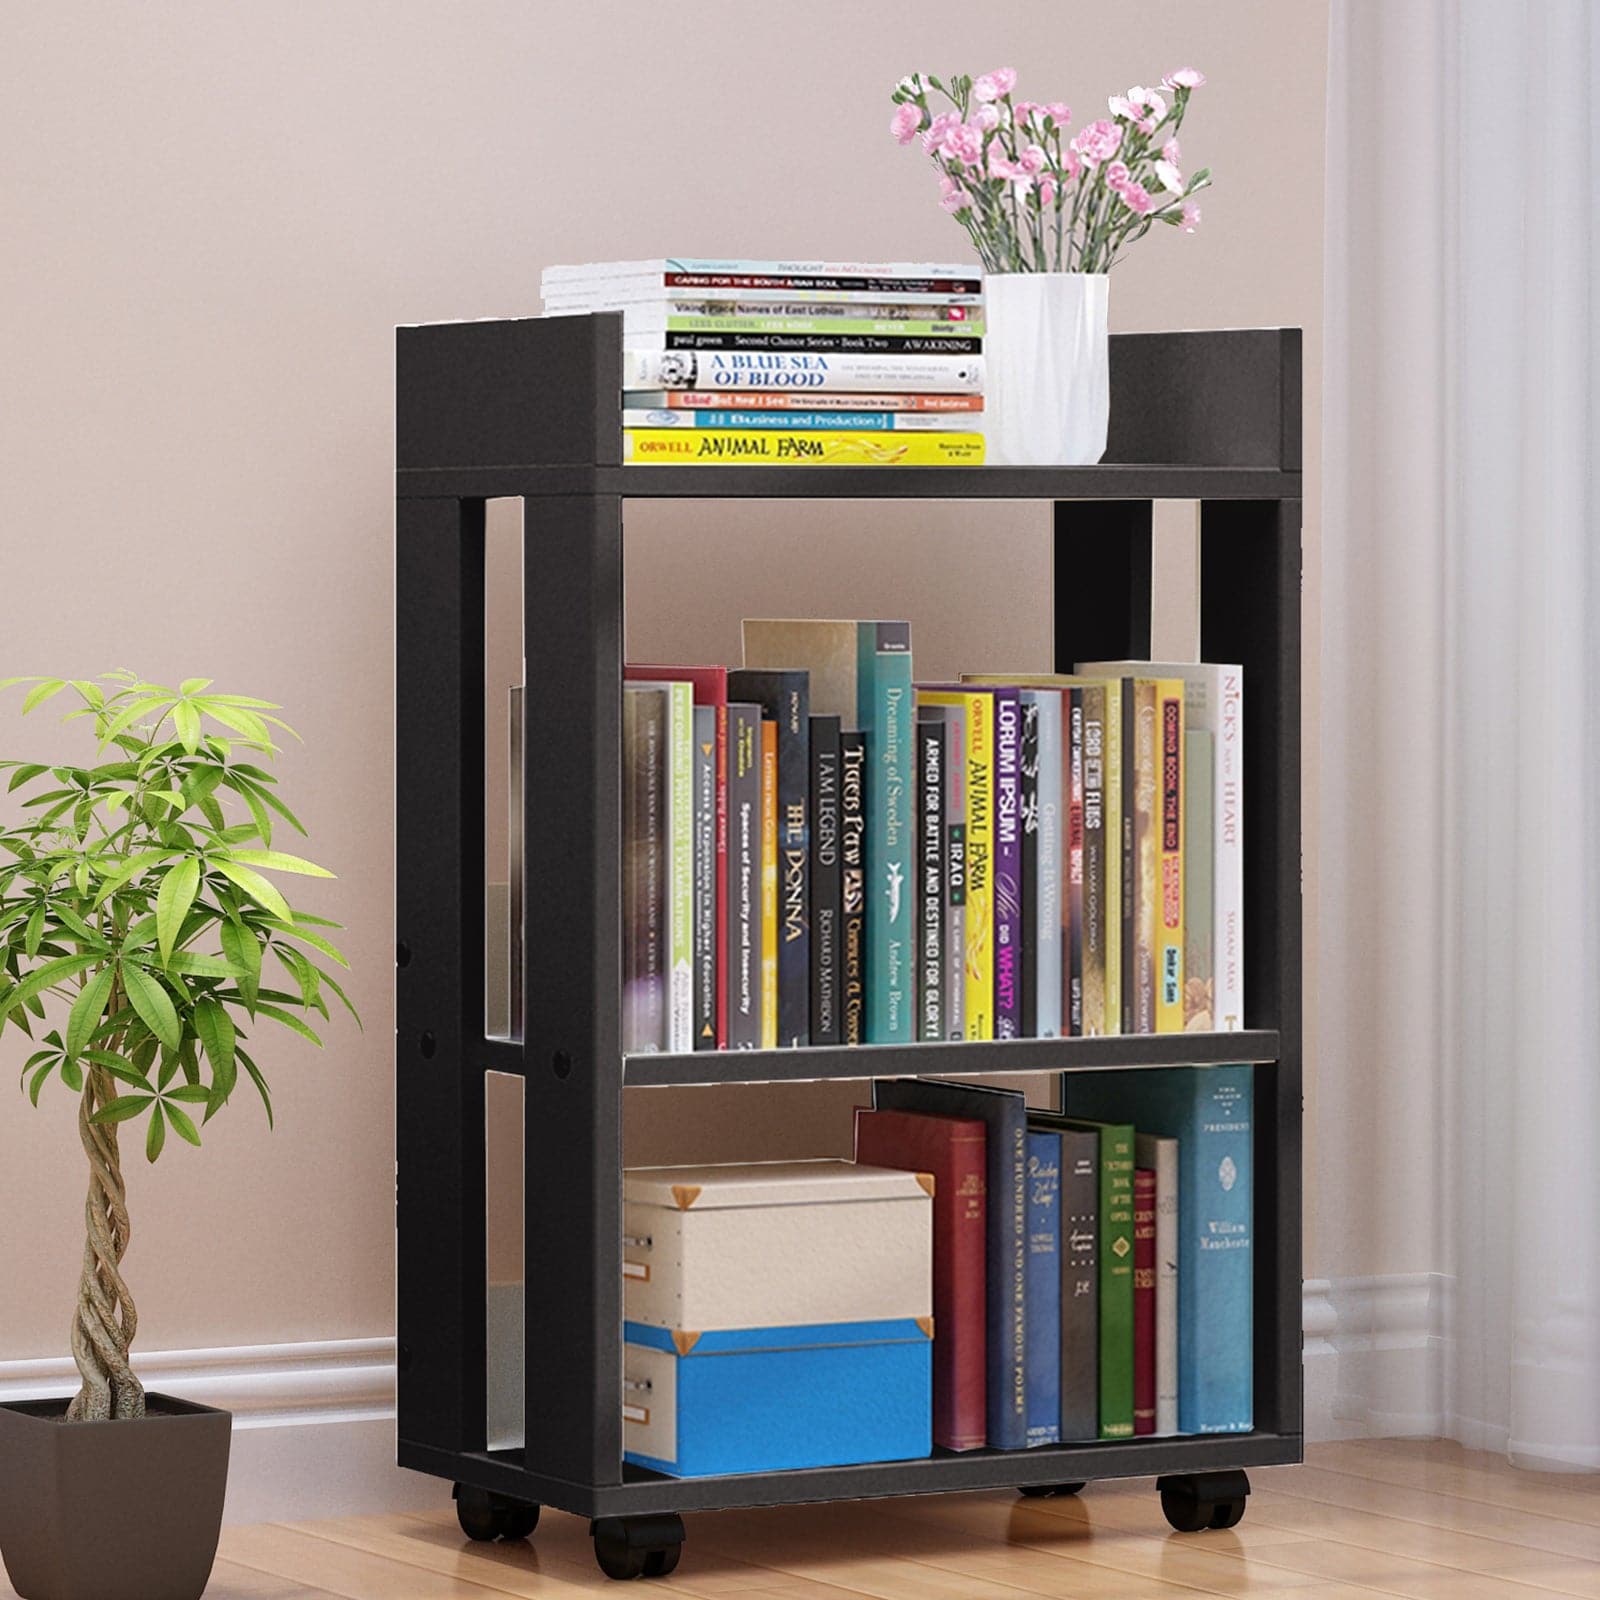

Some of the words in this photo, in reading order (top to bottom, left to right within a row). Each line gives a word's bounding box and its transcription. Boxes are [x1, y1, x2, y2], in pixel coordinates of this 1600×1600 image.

[674, 276, 710, 284] CARING
[712, 277, 731, 285] FOR
[733, 277, 751, 285] THE
[787, 278, 814, 287] ASIAN
[675, 303, 706, 315] Viking
[737, 304, 770, 315] Names
[772, 305, 783, 315] of
[785, 305, 807, 315] East
[809, 305, 845, 317] Lothian
[673, 334, 695, 347] paul
[696, 336, 723, 347] green
[735, 334, 768, 346] Second
[770, 335, 806, 347] Chance
[807, 336, 835, 347] Series
[841, 337, 865, 347] Book
[868, 338, 889, 348] Two
[903, 340, 973, 351] AWAKENING
[711, 355, 725, 369] A
[732, 355, 788, 370] BLUE
[790, 356, 829, 371] SEA
[714, 372, 744, 386] OF
[750, 372, 825, 387] BLOOD
[791, 413, 811, 425] and
[814, 413, 875, 425] Production
[639, 441, 693, 454] ORWELL
[698, 437, 771, 457] ANIMAL
[776, 438, 824, 458] FARM
[883, 687, 903, 763] Dreaming
[972, 699, 983, 755] ORWELL
[999, 700, 1016, 773] LORUM
[1086, 721, 1101, 756] LORD
[1165, 704, 1177, 753] COMING
[819, 763, 835, 794] AM
[886, 766, 903, 783] of
[926, 739, 939, 782] ARMED
[703, 764, 713, 809] Access
[926, 786, 939, 811] FOR
[969, 759, 987, 836] ANIMAL
[1165, 796, 1177, 819] THE
[703, 811, 712, 822] &
[741, 802, 751, 849] Spaces
[785, 799, 806, 845] THE
[819, 799, 835, 866] LEGEND
[886, 785, 903, 846] Sweden
[999, 778, 1016, 842] IPSUM
[1086, 791, 1101, 829] FLIES
[1223, 782, 1236, 847] HEART
[926, 814, 939, 861] BATTLE
[1039, 802, 1056, 866] Getting
[1165, 822, 1177, 848] END
[701, 825, 712, 890] Expansion
[741, 851, 751, 863] of
[951, 843, 963, 887] IRAQ
[970, 842, 988, 892] FARM
[703, 893, 712, 905] in
[740, 866, 751, 921] Security
[785, 848, 806, 942] DONNA
[926, 866, 939, 894] AND
[995, 872, 1019, 920] She
[701, 909, 712, 951] Higher
[926, 896, 939, 958] DESTINED
[1039, 881, 1056, 941] Wrong
[1088, 895, 1097, 953] GOLDING
[1226, 911, 1236, 956] SUSAN
[741, 922, 750, 947] and
[819, 909, 834, 966] RICHARD
[999, 923, 1009, 945] DID
[702, 954, 712, 1018] Education
[740, 948, 751, 1015] Insecurity
[889, 940, 902, 987] Andrew
[926, 960, 939, 986] FOR
[998, 945, 1013, 1009] WHAT?
[1226, 961, 1236, 992] MAY
[818, 967, 833, 1034] MATHESON
[889, 989, 901, 1031] Brown
[1014, 1128, 1024, 1158] ONE
[1202, 1122, 1249, 1132] PRESIDENT
[1014, 1162, 1024, 1234] HUNDRED
[1208, 1221, 1246, 1234] William
[1014, 1239, 1024, 1269] AND
[1014, 1272, 1024, 1301] ONE
[1014, 1307, 1024, 1363] FAMOUS
[1014, 1366, 1024, 1415] POEMS
